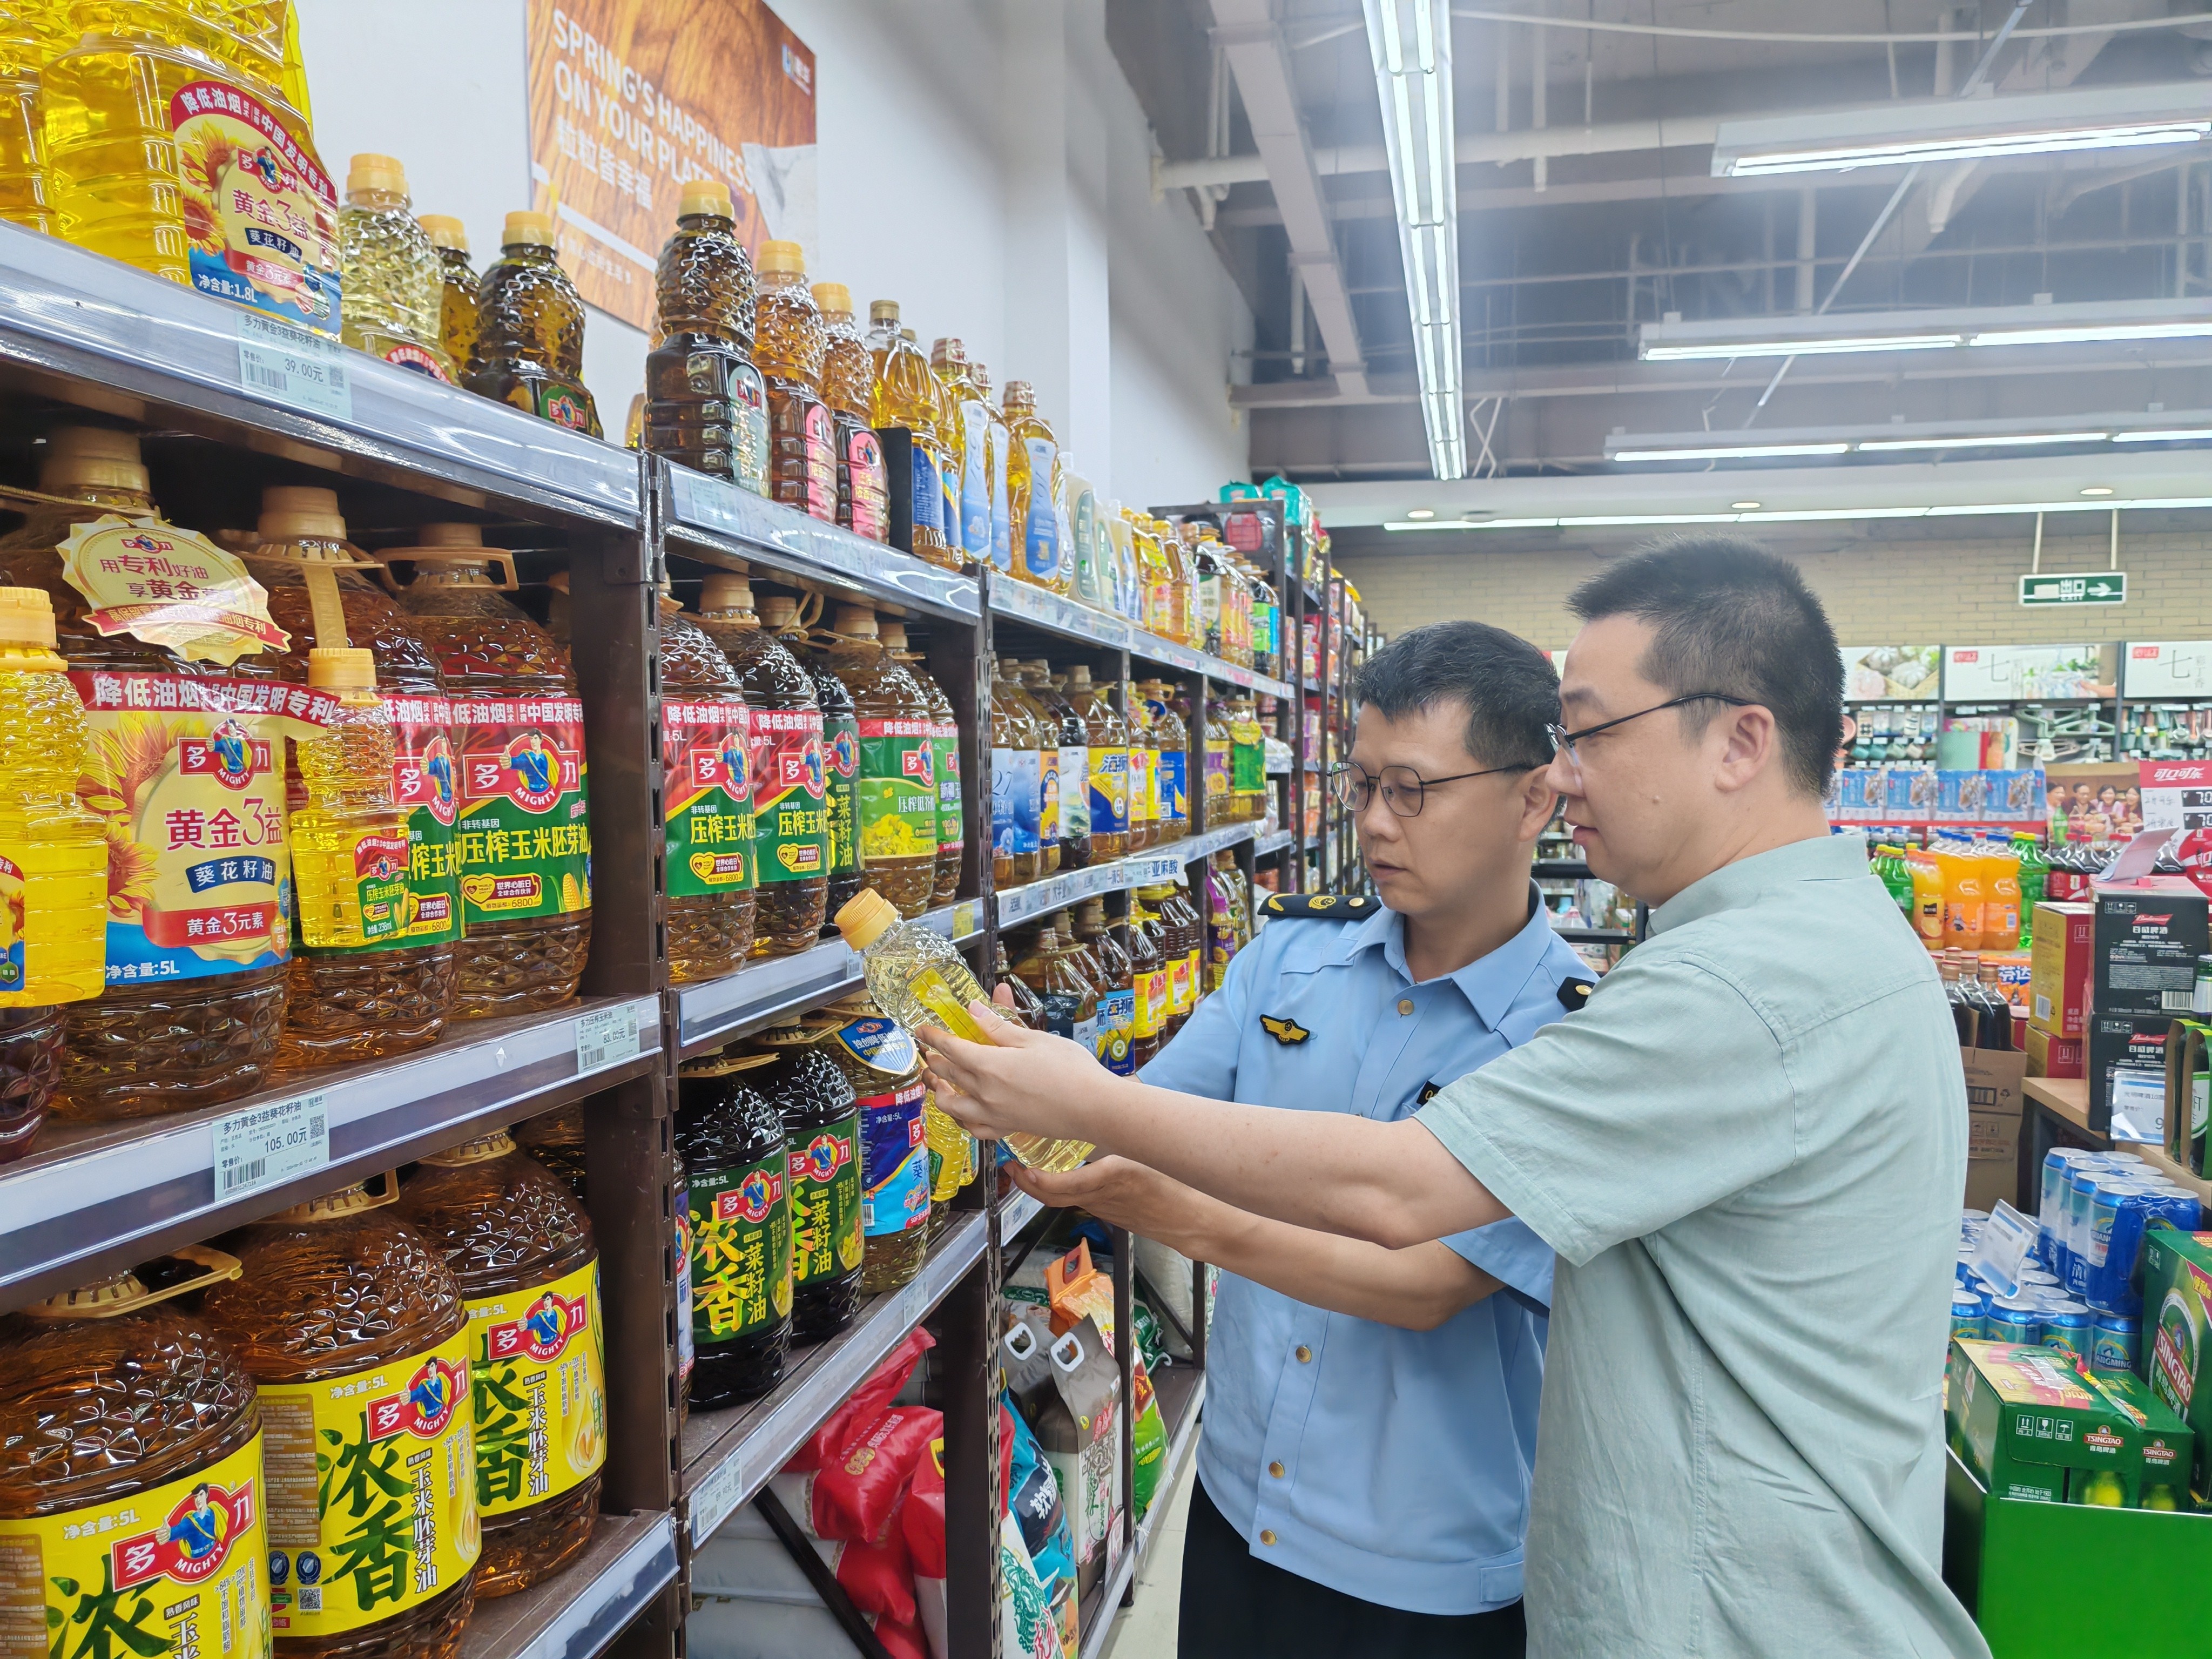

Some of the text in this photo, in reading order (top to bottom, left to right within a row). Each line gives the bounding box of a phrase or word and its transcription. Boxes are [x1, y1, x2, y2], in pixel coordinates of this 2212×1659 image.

[553, 8, 655, 118] SPRING'S
[658, 92, 754, 195] HAPPINESS
[554, 59, 713, 185] ON YOUR PLAT
[233, 189, 309, 240] 黄金3益
[249, 230, 300, 261] 葵花籽油
[198, 274, 258, 304] 净含量:1.8L
[285, 358, 323, 382] 39.00元
[99, 555, 209, 579] 用专利好油
[2060, 579, 2086, 594] 出口
[94, 677, 198, 707] 降低油烟
[220, 683, 335, 724] 中国发明专利
[667, 705, 719, 724] 降低油烟
[758, 714, 803, 730] 降低油烟
[884, 721, 919, 735] 降低油烟
[698, 758, 716, 779] 多
[786, 760, 799, 779] 多
[907, 756, 918, 771] 多
[2154, 767, 2206, 781] 可口可乐
[218, 768, 250, 785] MIGHTY
[400, 768, 421, 796] 多
[515, 787, 556, 805] MIGHTY
[691, 805, 717, 814] 非转基因
[165, 798, 283, 851] 黄金3益
[462, 818, 500, 830] 非转基因
[837, 794, 853, 867] 菜籽油
[461, 822, 588, 865] 压榨玉米胚芽油
[196, 860, 272, 886] 葵花籽油
[1151, 859, 1178, 876] 亚麻酸
[497, 879, 531, 890] 世界心脏日
[497, 888, 531, 896] 全球合作伙伴
[420, 900, 446, 912] 世界心脏日
[186, 912, 264, 936] 黄金3元素
[105, 961, 180, 979] 净含量:5L
[1998, 966, 2031, 981] 芬达
[224, 1101, 301, 1135] 多力黄金3益葵花籽油
[265, 1127, 307, 1153] 105.00元
[912, 1123, 921, 1141] 多
[692, 1175, 729, 1188] 净含量:5L
[813, 1165, 835, 1177] MIGHTY
[746, 1204, 768, 1218] MIGHTY
[810, 1199, 832, 1274] 菜籽油
[745, 1242, 766, 1324] 菜籽油
[530, 1337, 563, 1355] MIGHTY
[2156, 1328, 2191, 1403] TSINGTAO
[329, 1374, 388, 1400] 净含量:5L
[414, 1407, 449, 1431] MIGHTY
[526, 1384, 549, 1496] 玉米胚芽油
[2087, 1435, 2121, 1445] TSINGTAO
[2142, 1448, 2174, 1457] TSINGTAO
[320, 1410, 417, 1611] 浓香
[63, 1508, 141, 1540] 净含量:5L
[410, 1463, 437, 1594] 玉米胚芽油
[174, 1543, 226, 1574] MIGHTY
[165, 1596, 199, 1618] 熟香风味
